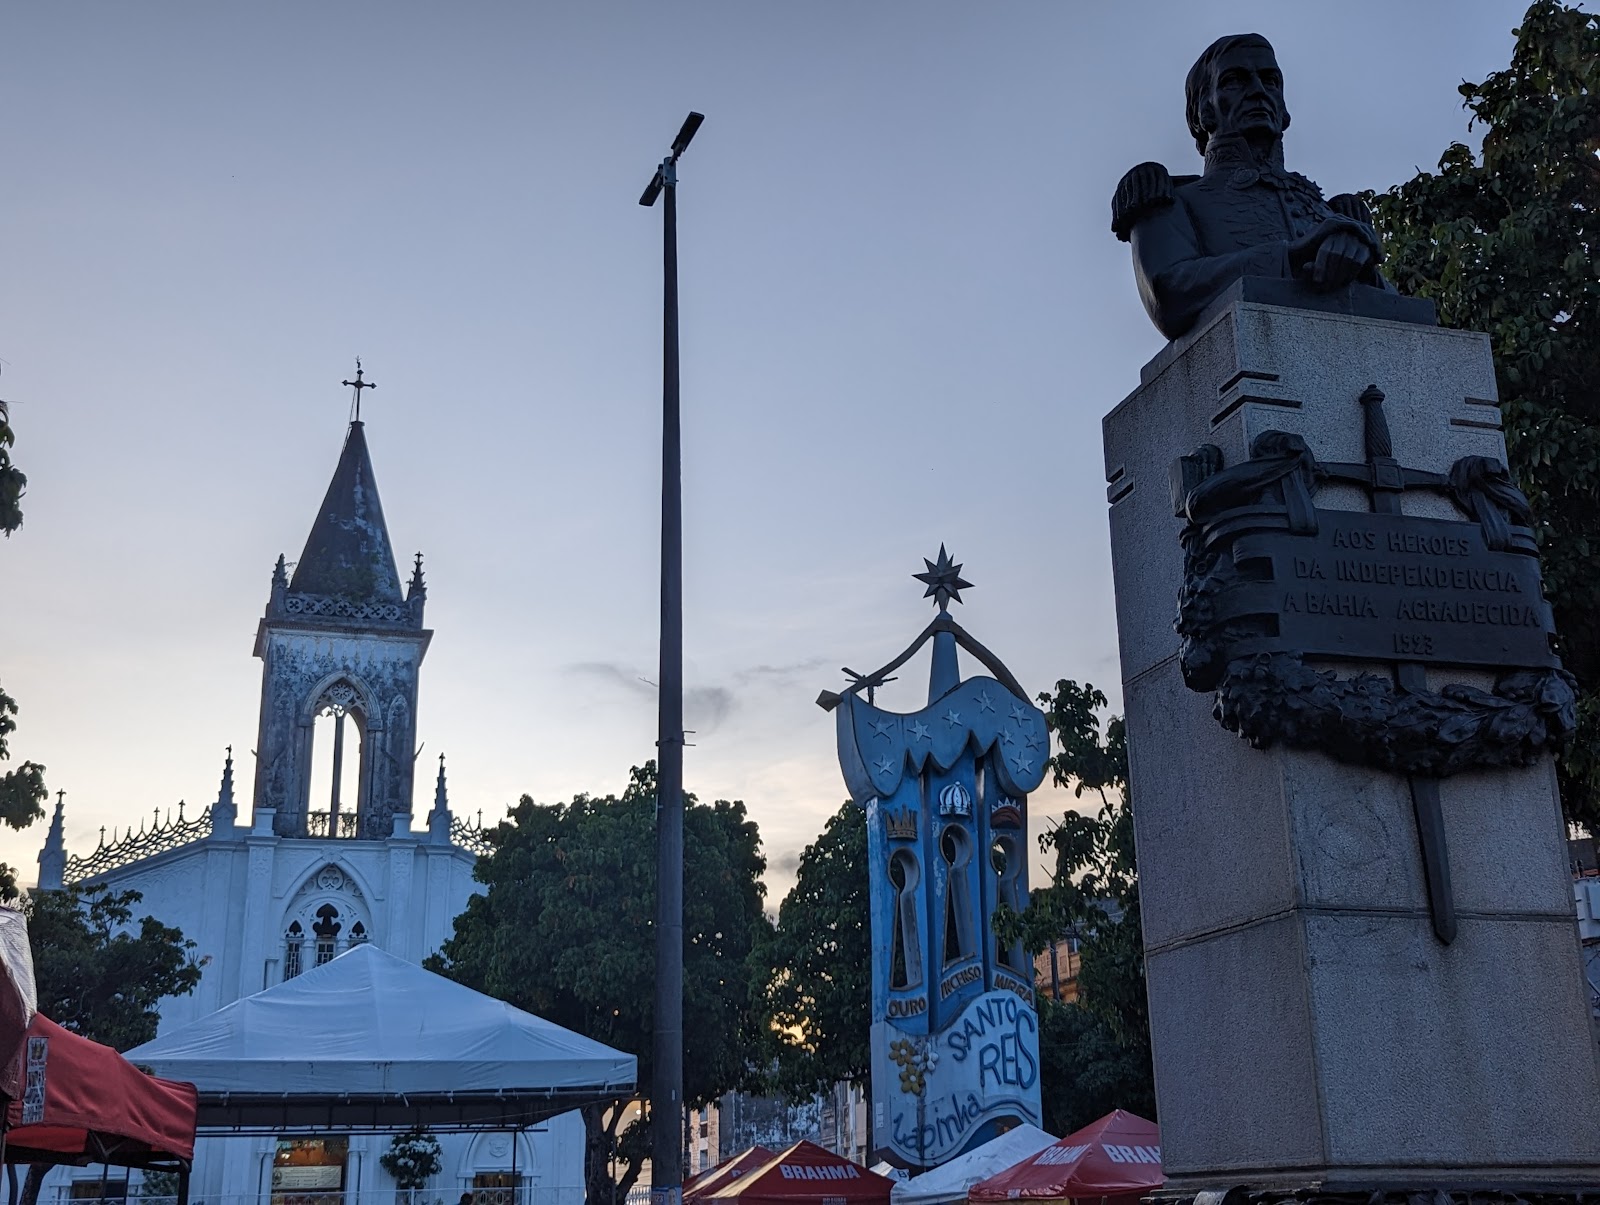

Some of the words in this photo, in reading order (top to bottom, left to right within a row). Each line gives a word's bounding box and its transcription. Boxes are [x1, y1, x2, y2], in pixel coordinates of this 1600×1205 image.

[1333, 527, 1376, 551] AOS
[1387, 531, 1470, 557] HEROES
[1294, 557, 1326, 580] DA
[1336, 560, 1522, 593] INDEPENDENCIA
[1283, 592, 1300, 613] A
[1305, 593, 1379, 619] BAHIA
[1397, 600, 1541, 627] AGRADECIDA
[940, 965, 982, 1000] INCENSO
[994, 973, 1034, 1007] MIRRA
[888, 997, 927, 1017] OURO
[980, 1009, 1037, 1090] REIS
[779, 1163, 861, 1180] BRAHMA
